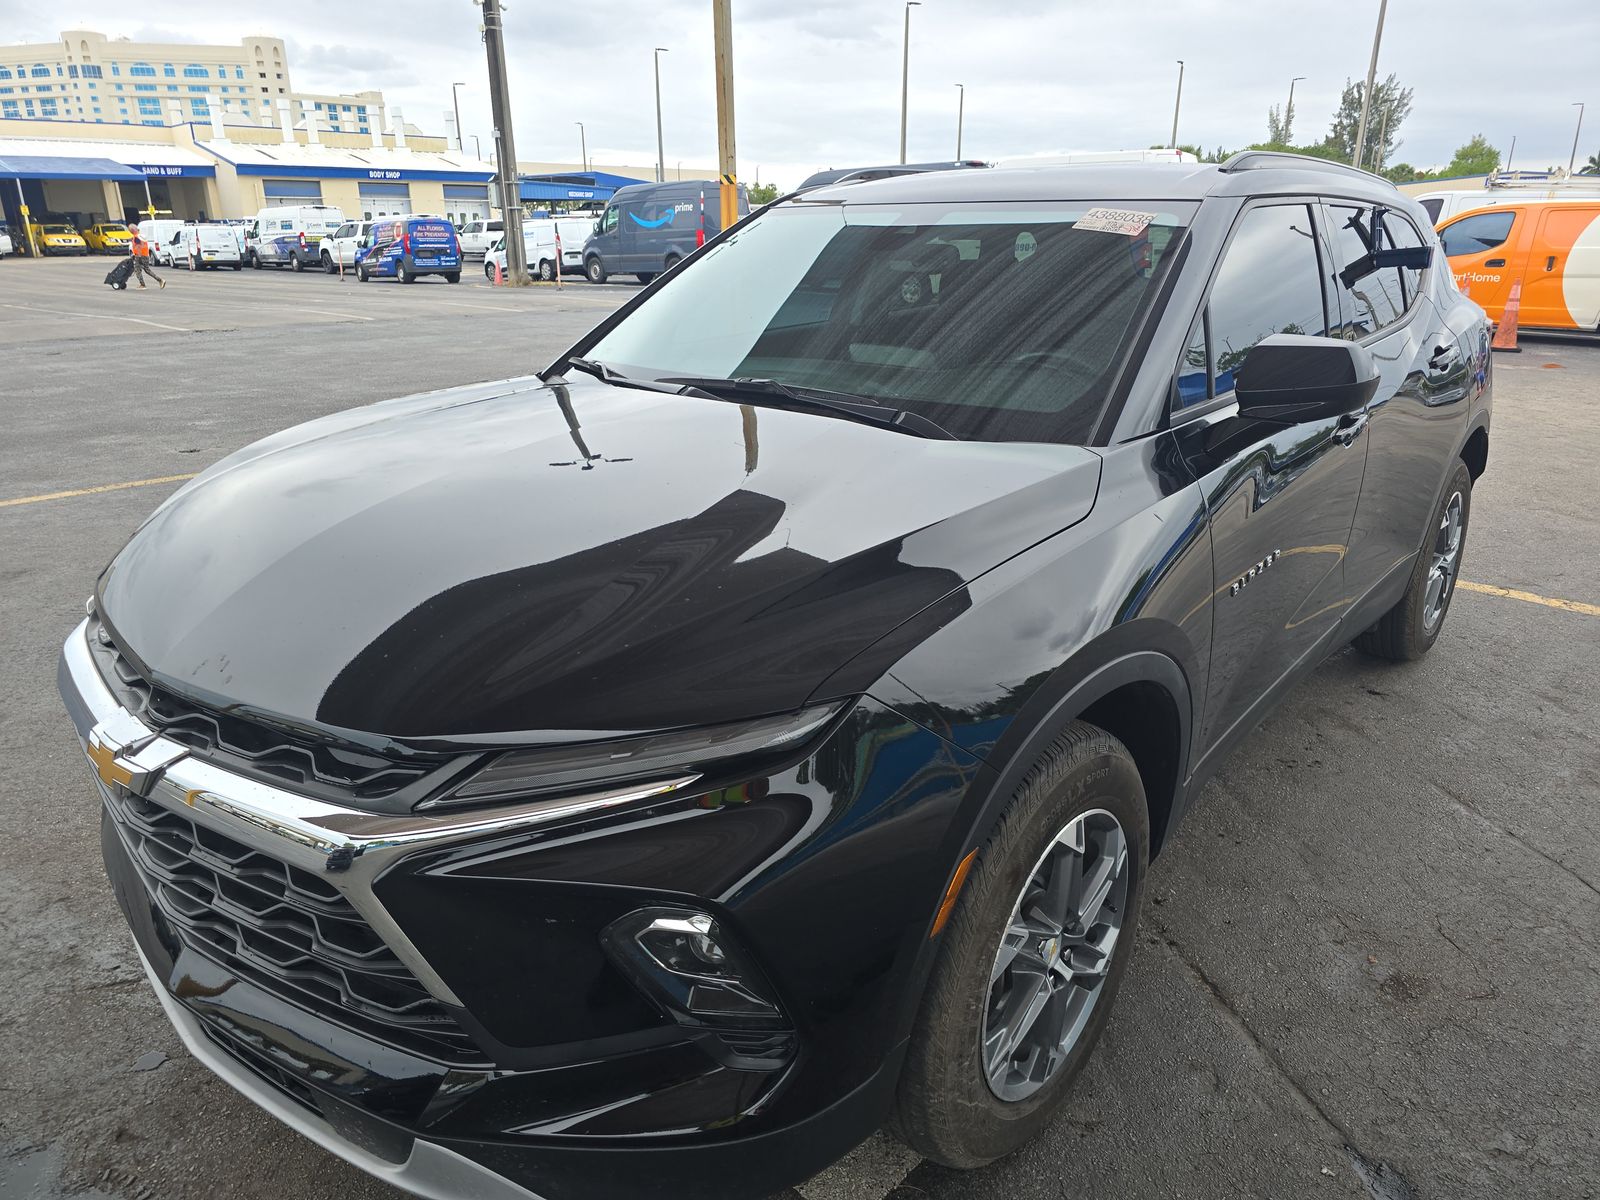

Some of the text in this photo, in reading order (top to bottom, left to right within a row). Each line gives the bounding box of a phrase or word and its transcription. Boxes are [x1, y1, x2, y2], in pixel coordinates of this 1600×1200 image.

[142, 167, 159, 175] SAND
[167, 167, 182, 175] BUFF
[385, 171, 401, 179] SHOP
[674, 202, 694, 215] prime
[1088, 210, 1154, 225] 4388038
[1453, 272, 1501, 283] artHome
[1086, 767, 1110, 785] SPORT
